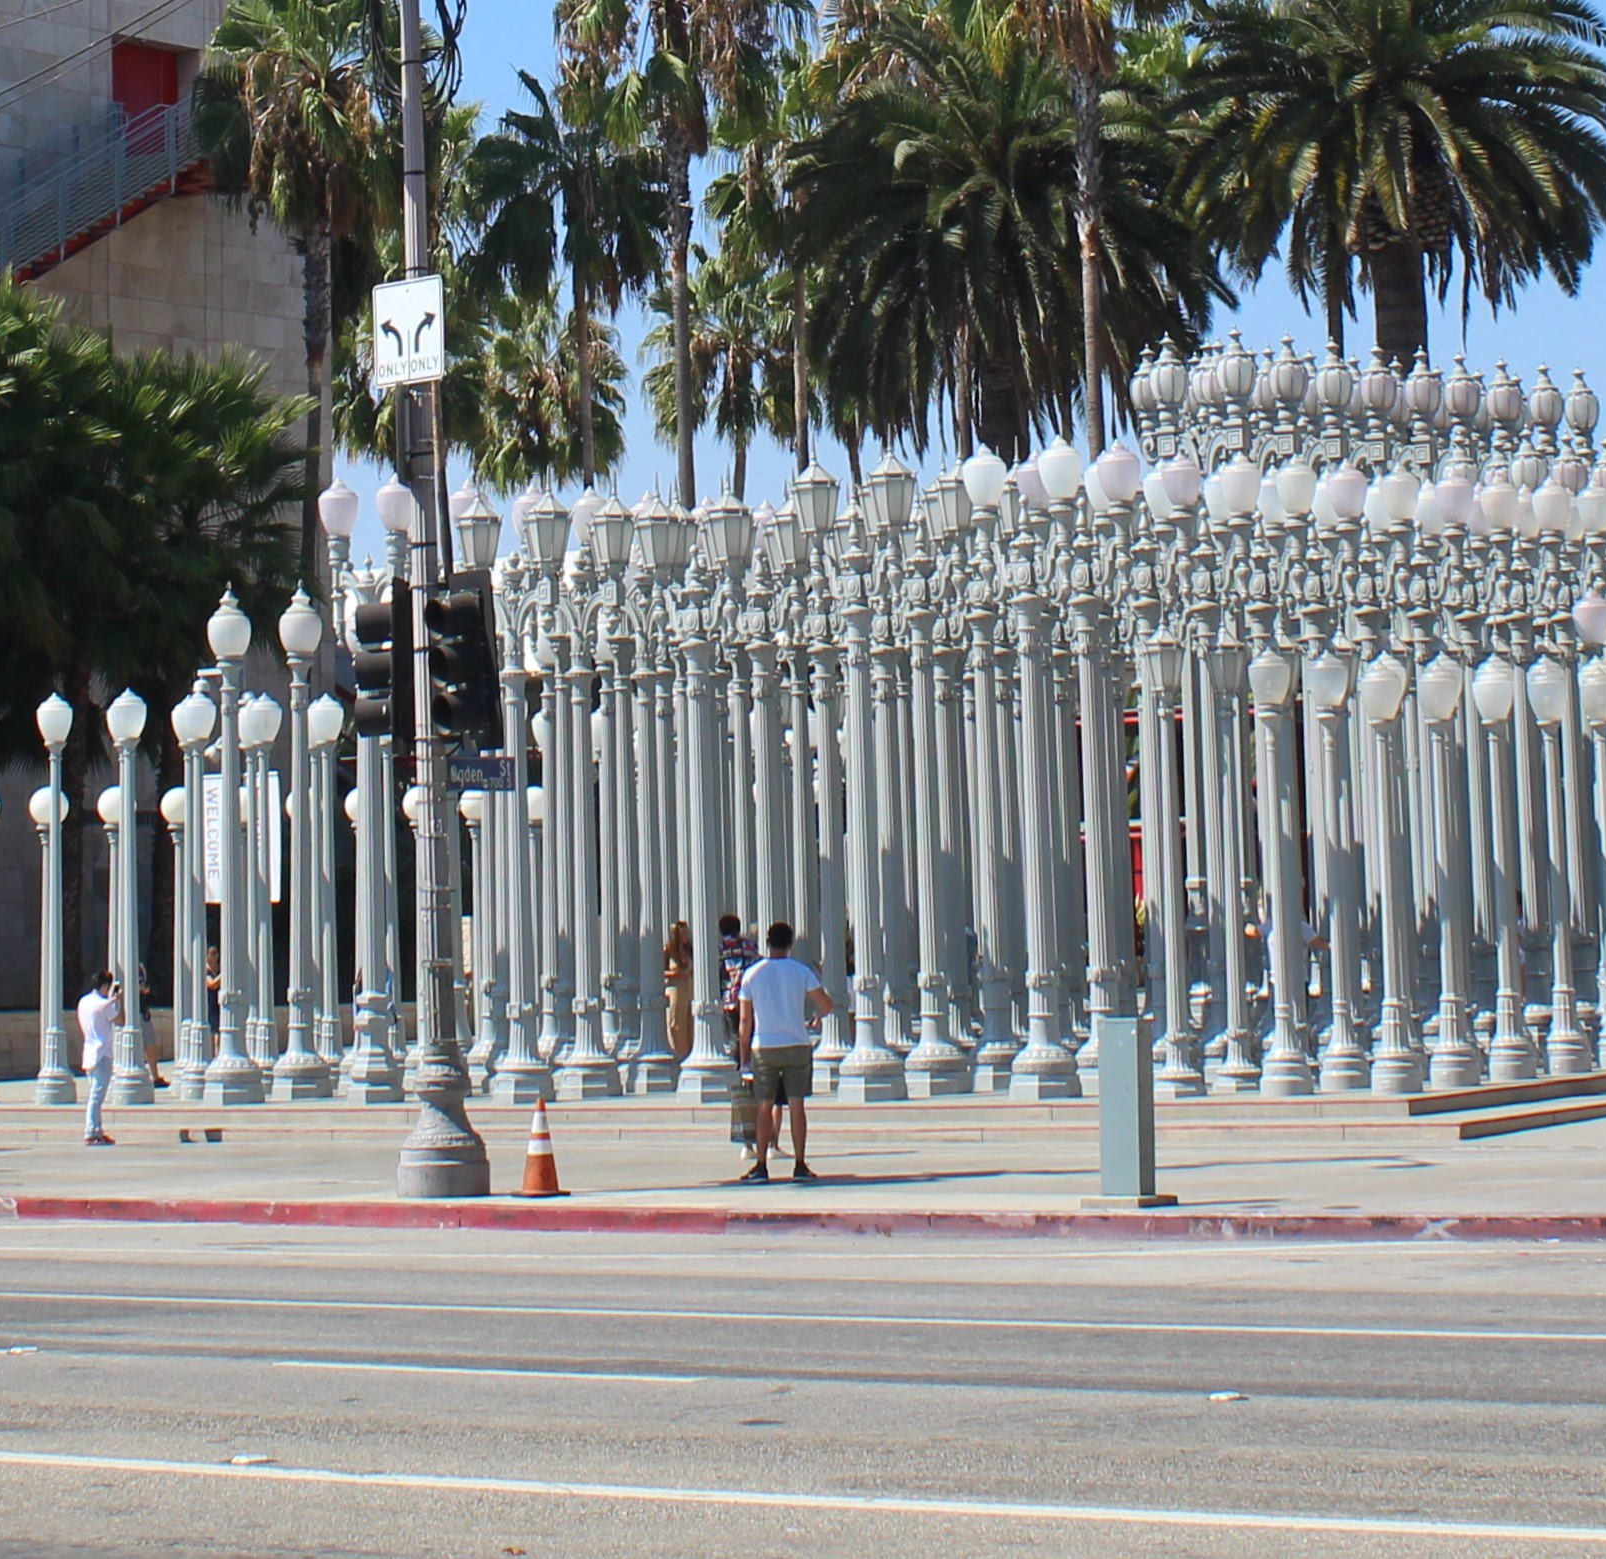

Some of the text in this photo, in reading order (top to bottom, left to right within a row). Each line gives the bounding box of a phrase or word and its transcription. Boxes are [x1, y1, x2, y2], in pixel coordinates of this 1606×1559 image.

[378, 355, 439, 378] ONLY ONLY
[205, 786, 220, 881] WELCOME
